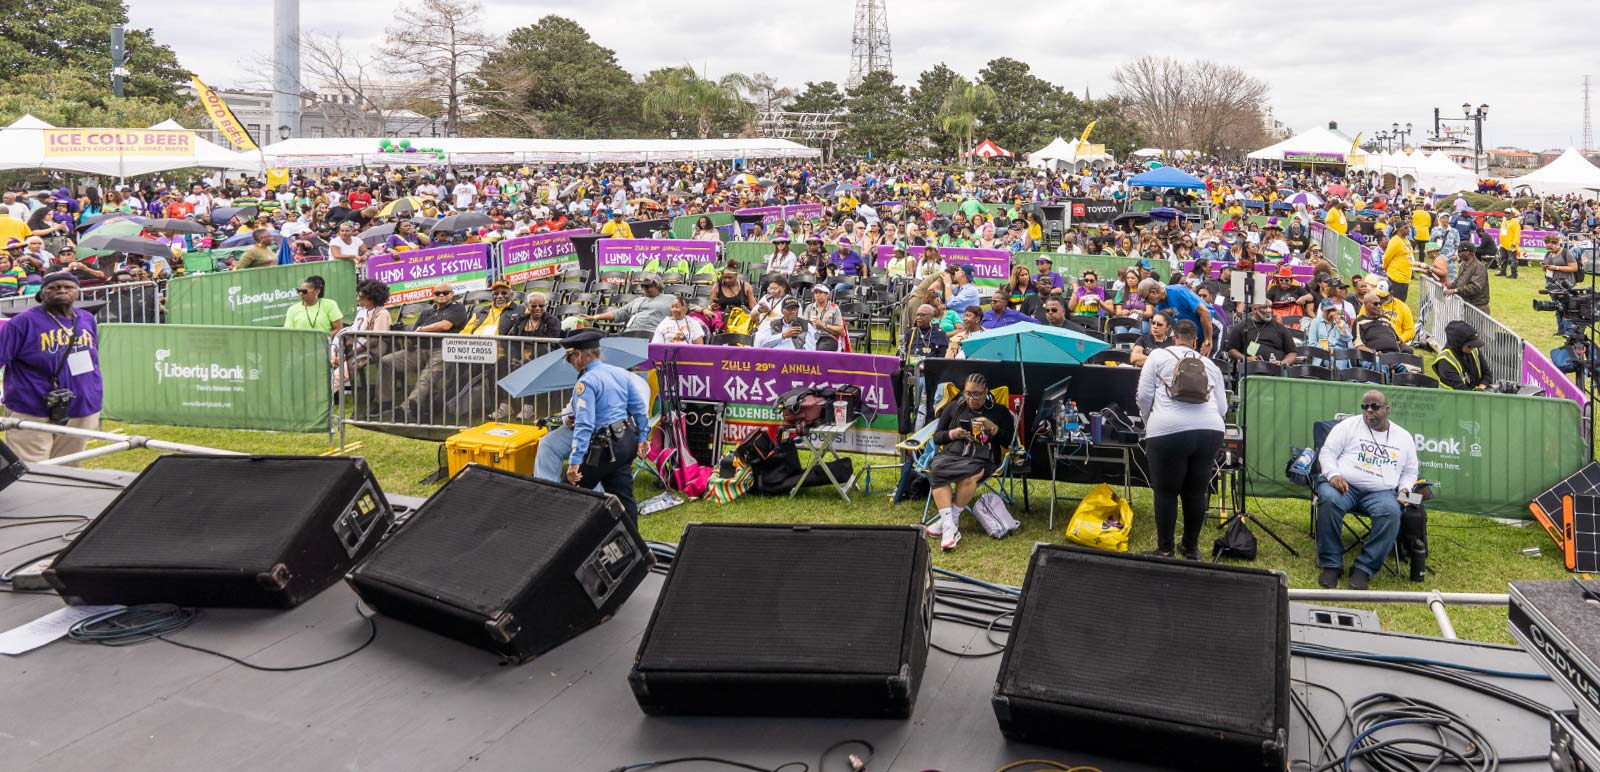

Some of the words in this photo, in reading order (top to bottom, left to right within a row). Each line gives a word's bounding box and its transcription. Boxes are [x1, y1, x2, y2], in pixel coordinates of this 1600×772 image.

[50, 134, 82, 145] ICE
[87, 133, 139, 145] COLD
[143, 134, 189, 145] BEER
[220, 119, 245, 144] BEER
[508, 250, 530, 264] LUNDI
[533, 245, 552, 259] GRAS
[556, 242, 576, 255] FEST
[605, 253, 631, 264] LUNDI
[375, 268, 404, 283] LUNDI
[409, 263, 436, 279] GRAS
[441, 258, 483, 274] FESTIVAL
[974, 264, 1004, 277] TIVAL
[237, 291, 274, 305] Liberty
[275, 288, 298, 299] Bank
[403, 289, 432, 300] MARKETS
[471, 347, 492, 355] CROSS
[164, 362, 208, 382] Liberty
[211, 364, 244, 379] Bank
[721, 360, 751, 371] ZULU
[781, 364, 823, 375] ANNUAL
[723, 375, 779, 402] GRAS
[725, 407, 785, 420] OLDENBER
[1414, 433, 1460, 455] Bank
[1419, 460, 1443, 469] reedom
[1444, 462, 1461, 470] here.
